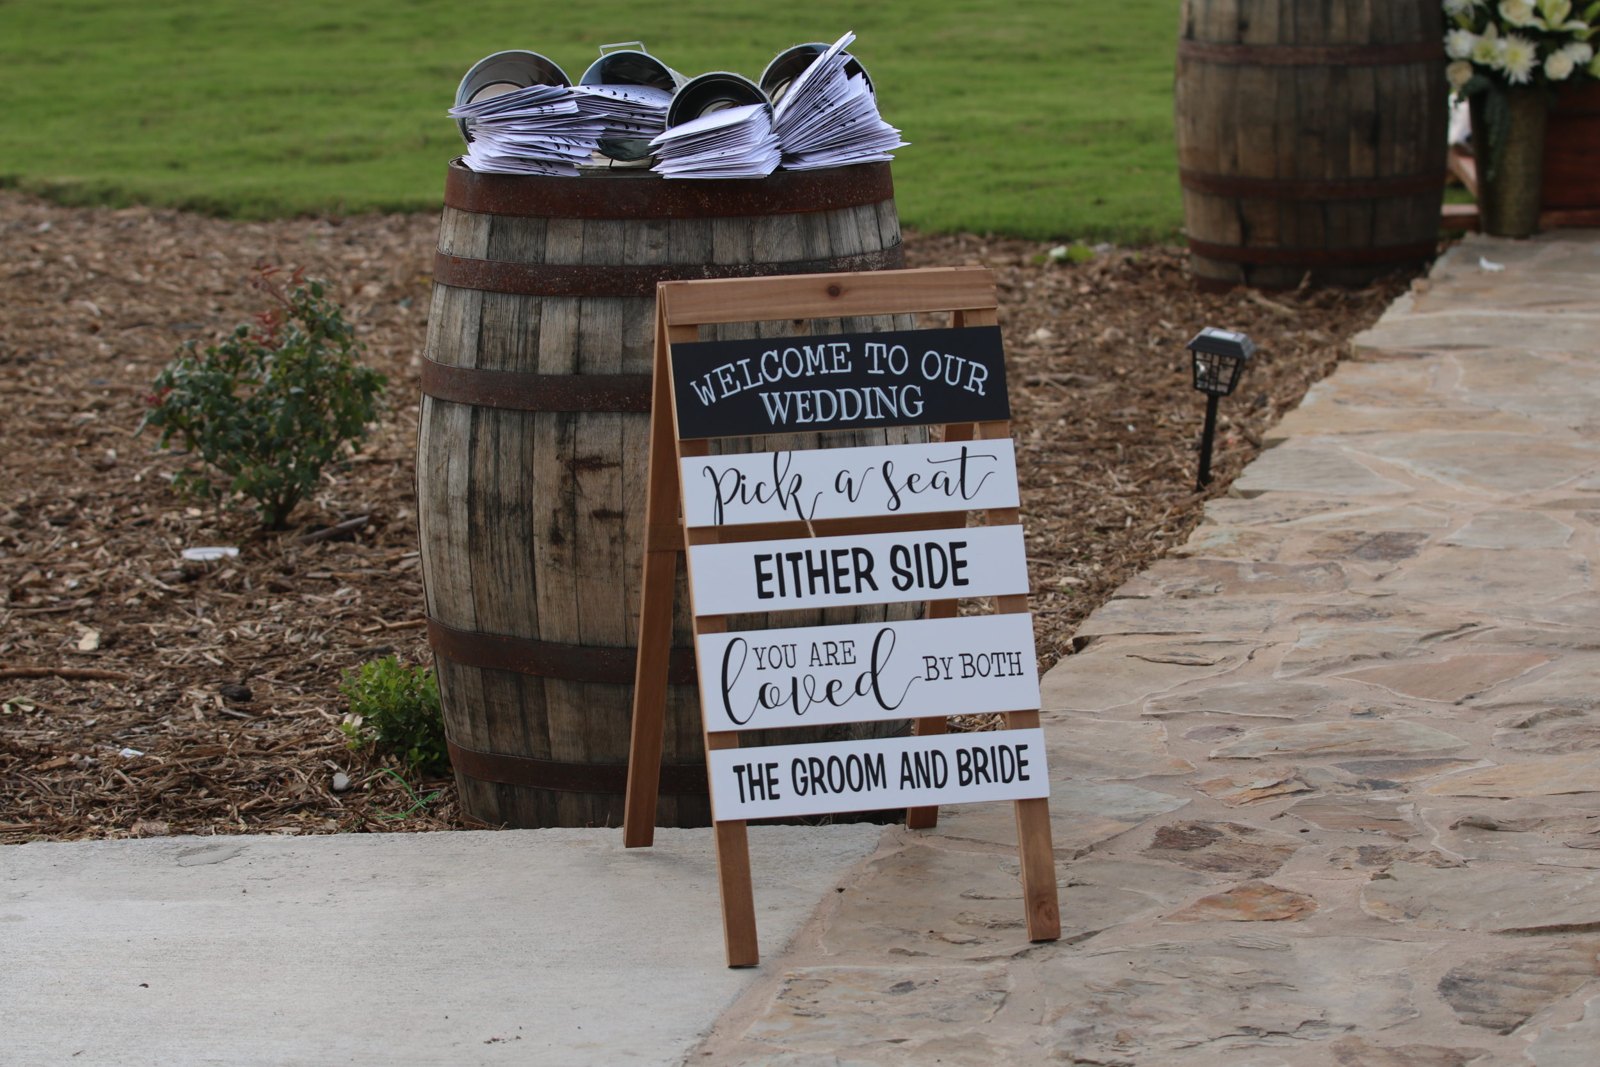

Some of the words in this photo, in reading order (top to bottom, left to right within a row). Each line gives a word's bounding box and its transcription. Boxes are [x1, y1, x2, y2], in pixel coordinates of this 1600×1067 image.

[690, 342, 852, 406] WELCOME
[864, 342, 909, 375] TO
[921, 350, 989, 396] OUR
[758, 384, 925, 425] WEDDING
[753, 546, 880, 600] EITHER
[889, 540, 970, 592] SIDE
[720, 627, 922, 726] loved
[752, 643, 797, 671] YOU
[808, 639, 857, 667] ARE
[921, 655, 954, 682] BY
[958, 651, 1024, 679] BOTH
[732, 762, 781, 804] THE
[791, 752, 888, 797] GROOM
[899, 749, 949, 791] AND
[955, 743, 1031, 788] BRIDE
